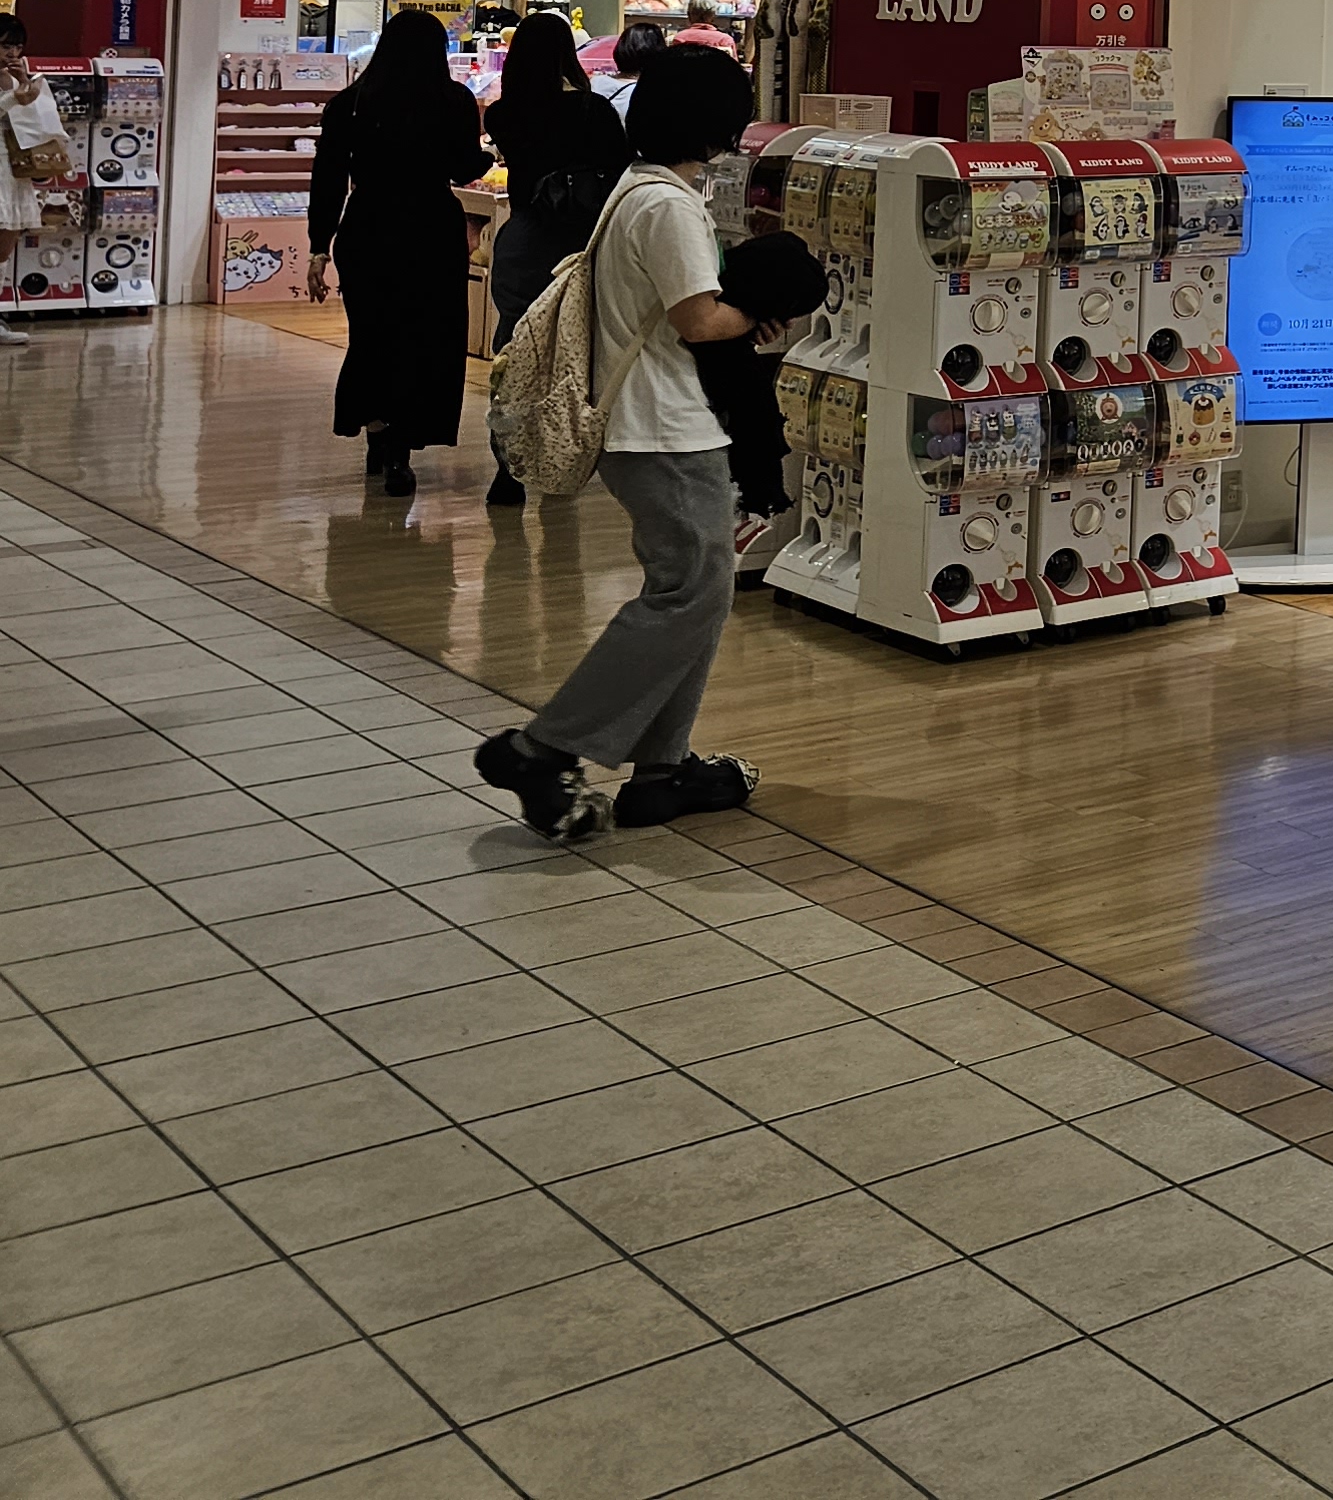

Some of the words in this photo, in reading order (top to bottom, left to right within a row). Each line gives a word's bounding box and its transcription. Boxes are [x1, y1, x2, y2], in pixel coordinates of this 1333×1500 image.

[1095, 34, 1128, 47] 万引き
[968, 160, 1008, 170] KIDDY
[1010, 160, 1039, 169] LAND
[1079, 159, 1112, 168] KIDDY
[1114, 157, 1144, 167] LAND
[1172, 156, 1205, 165] KIDDY
[1207, 155, 1233, 164] LAND
